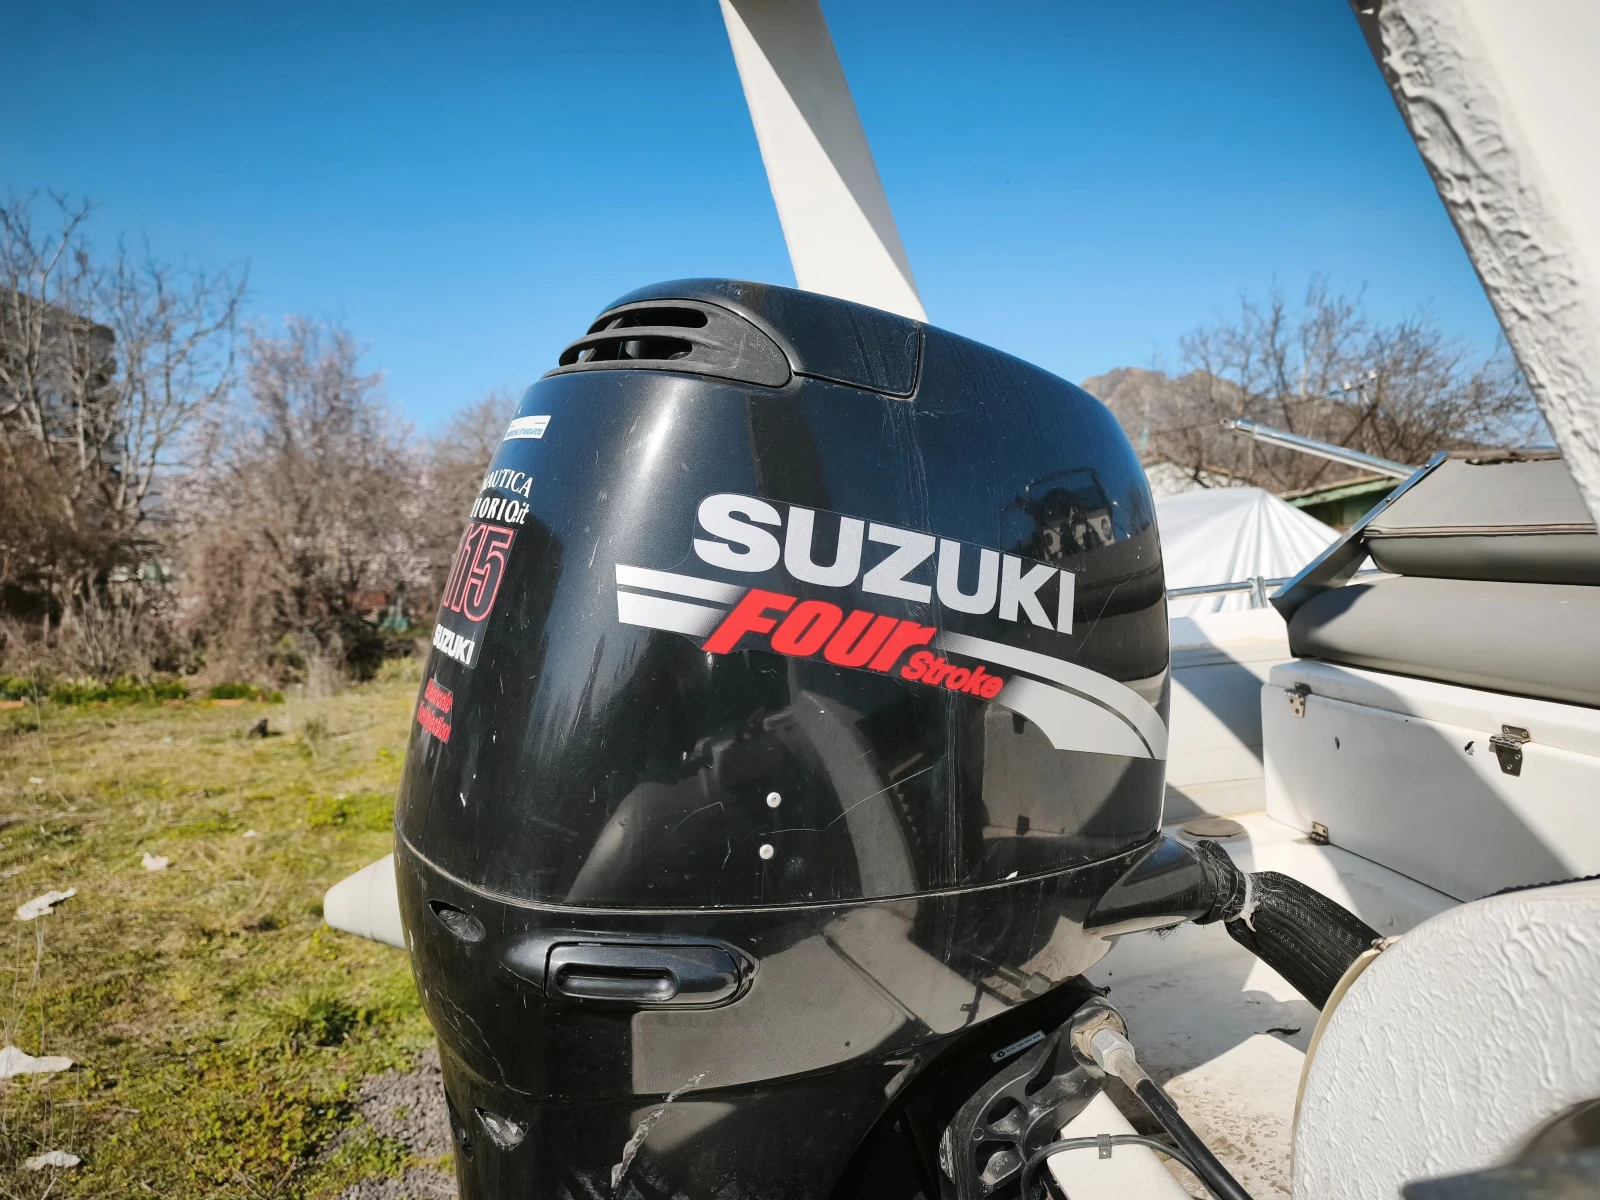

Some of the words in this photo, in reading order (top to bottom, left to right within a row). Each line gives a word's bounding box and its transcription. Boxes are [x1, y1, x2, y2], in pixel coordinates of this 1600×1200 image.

[443, 522, 515, 622] 115
[693, 493, 1076, 636] SUZUKI
[432, 623, 476, 665] SUZUKI
[901, 650, 1005, 700] Stroke
